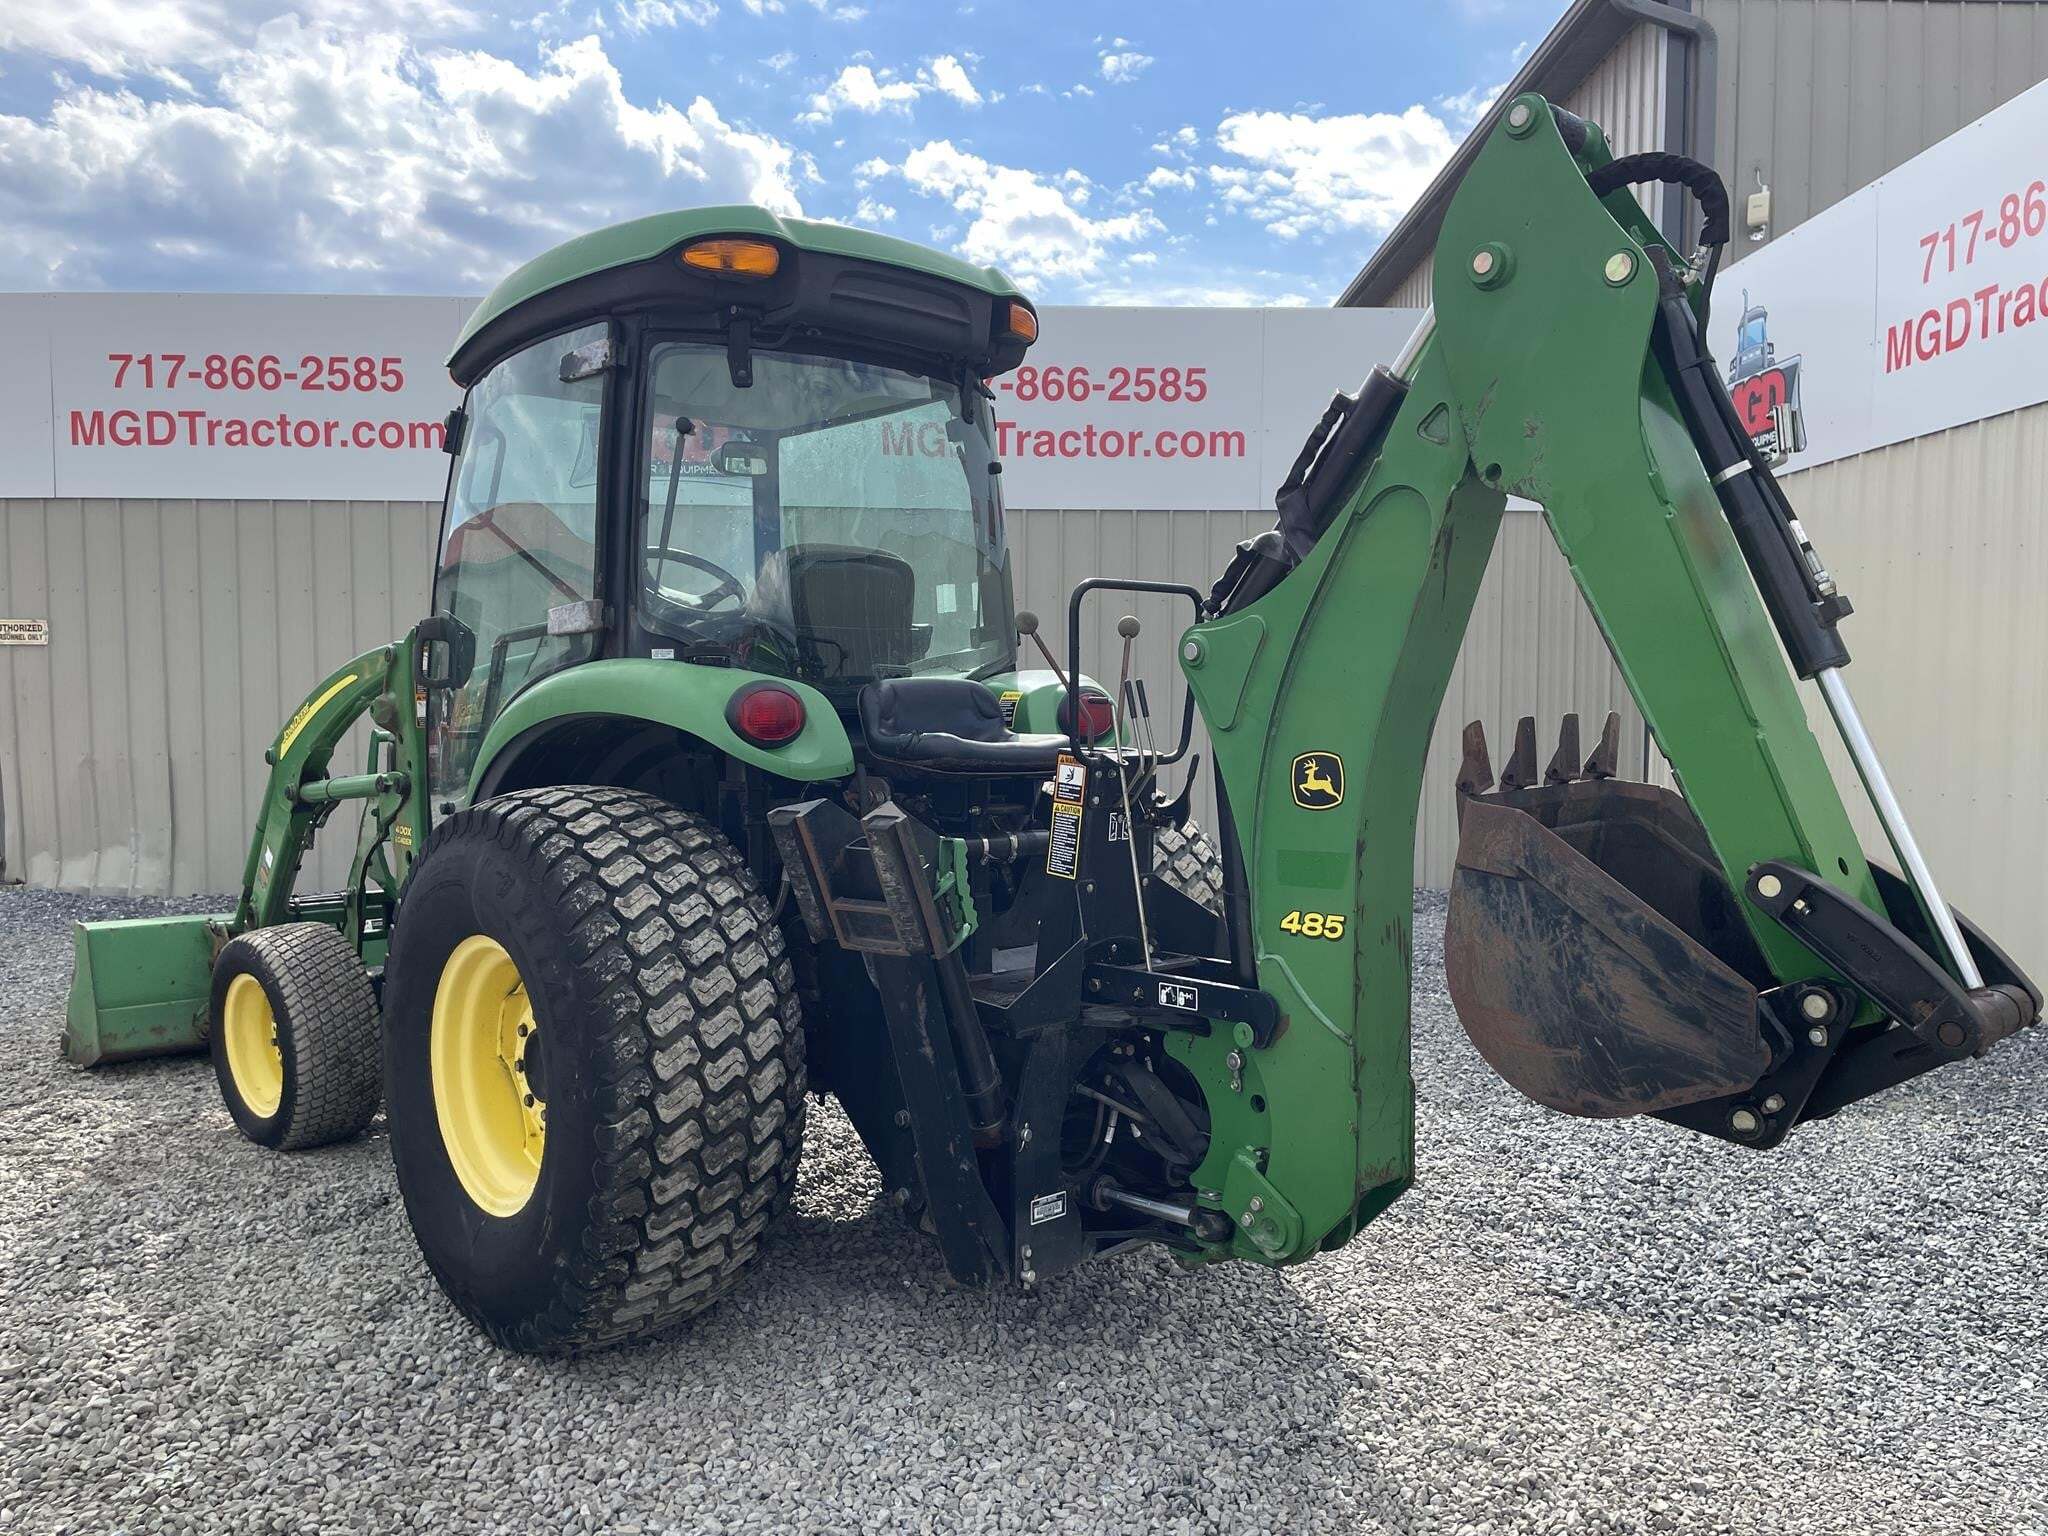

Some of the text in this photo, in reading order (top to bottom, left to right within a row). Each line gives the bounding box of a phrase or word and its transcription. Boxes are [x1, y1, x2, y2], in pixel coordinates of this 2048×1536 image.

[107, 354, 405, 393] 717-866-2585
[985, 366, 1207, 403] -866-2585
[69, 410, 446, 449] MGDTractor.com
[881, 421, 1246, 459] MGTractor.com
[1280, 911, 1346, 940] 485
